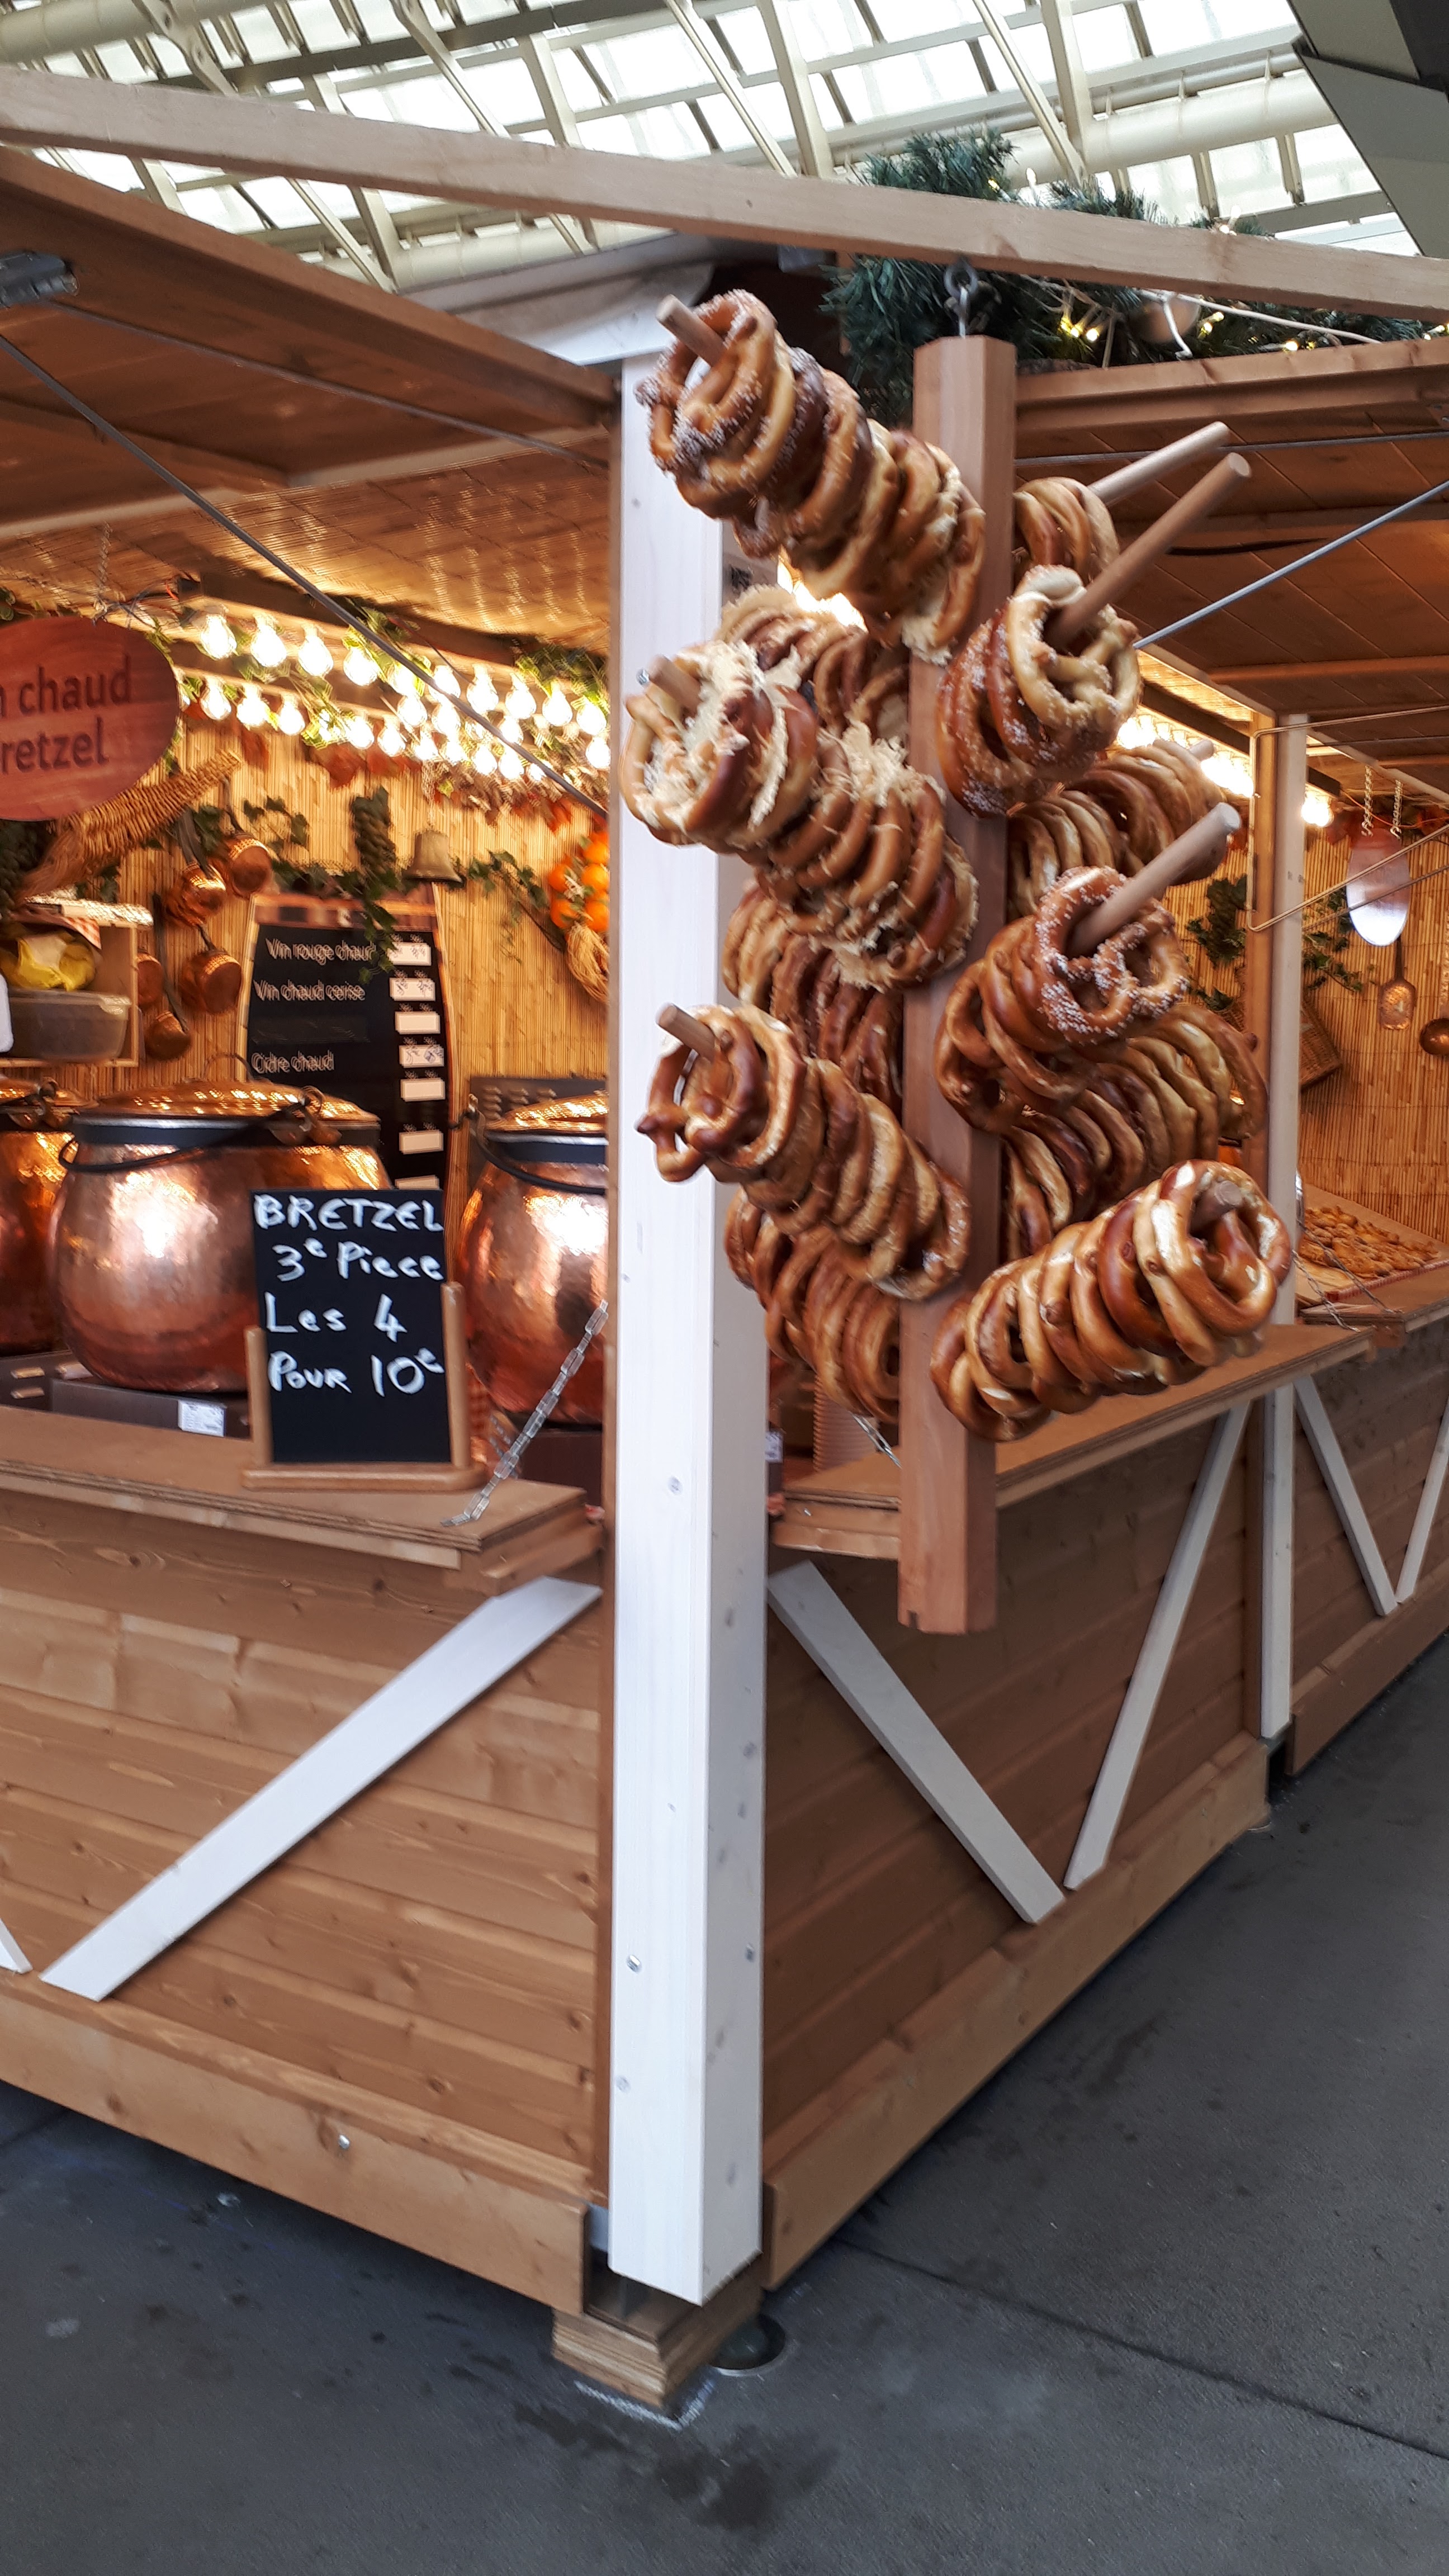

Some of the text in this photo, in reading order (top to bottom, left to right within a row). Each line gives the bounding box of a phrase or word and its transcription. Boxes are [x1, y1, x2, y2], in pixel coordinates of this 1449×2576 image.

[19, 654, 130, 716] chaud
[266, 938, 292, 960] Vin
[293, 943, 334, 966] rouge
[253, 979, 280, 1001] Vin
[281, 979, 325, 1001] chaud
[325, 981, 366, 1001] cerise
[252, 1049, 335, 1074] Cidre chaud
[254, 1194, 444, 1231] BRETZEL
[264, 1291, 408, 1342] Les 4
